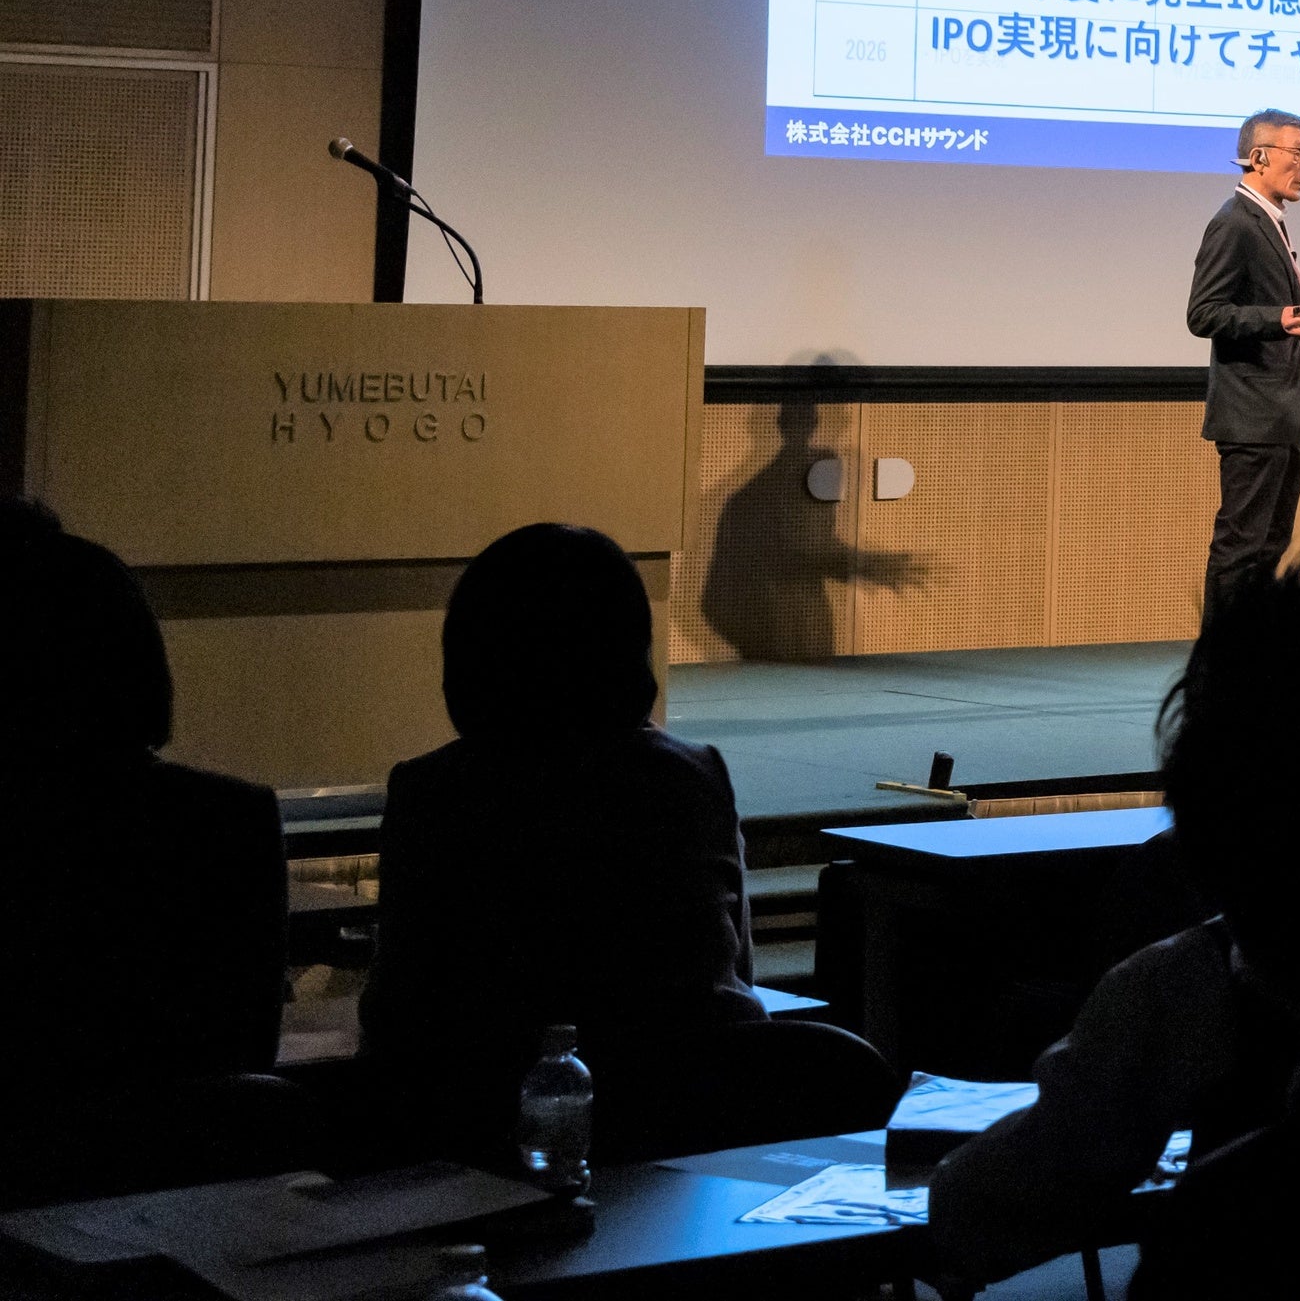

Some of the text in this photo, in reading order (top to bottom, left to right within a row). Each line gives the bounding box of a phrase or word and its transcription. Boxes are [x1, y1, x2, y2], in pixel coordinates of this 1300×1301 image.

[844, 39, 888, 63] 2026
[785, 119, 989, 152] 株式会社CCHサウンド
[273, 371, 488, 403] YUMEBUTAI
[270, 411, 487, 444] HYOGO
